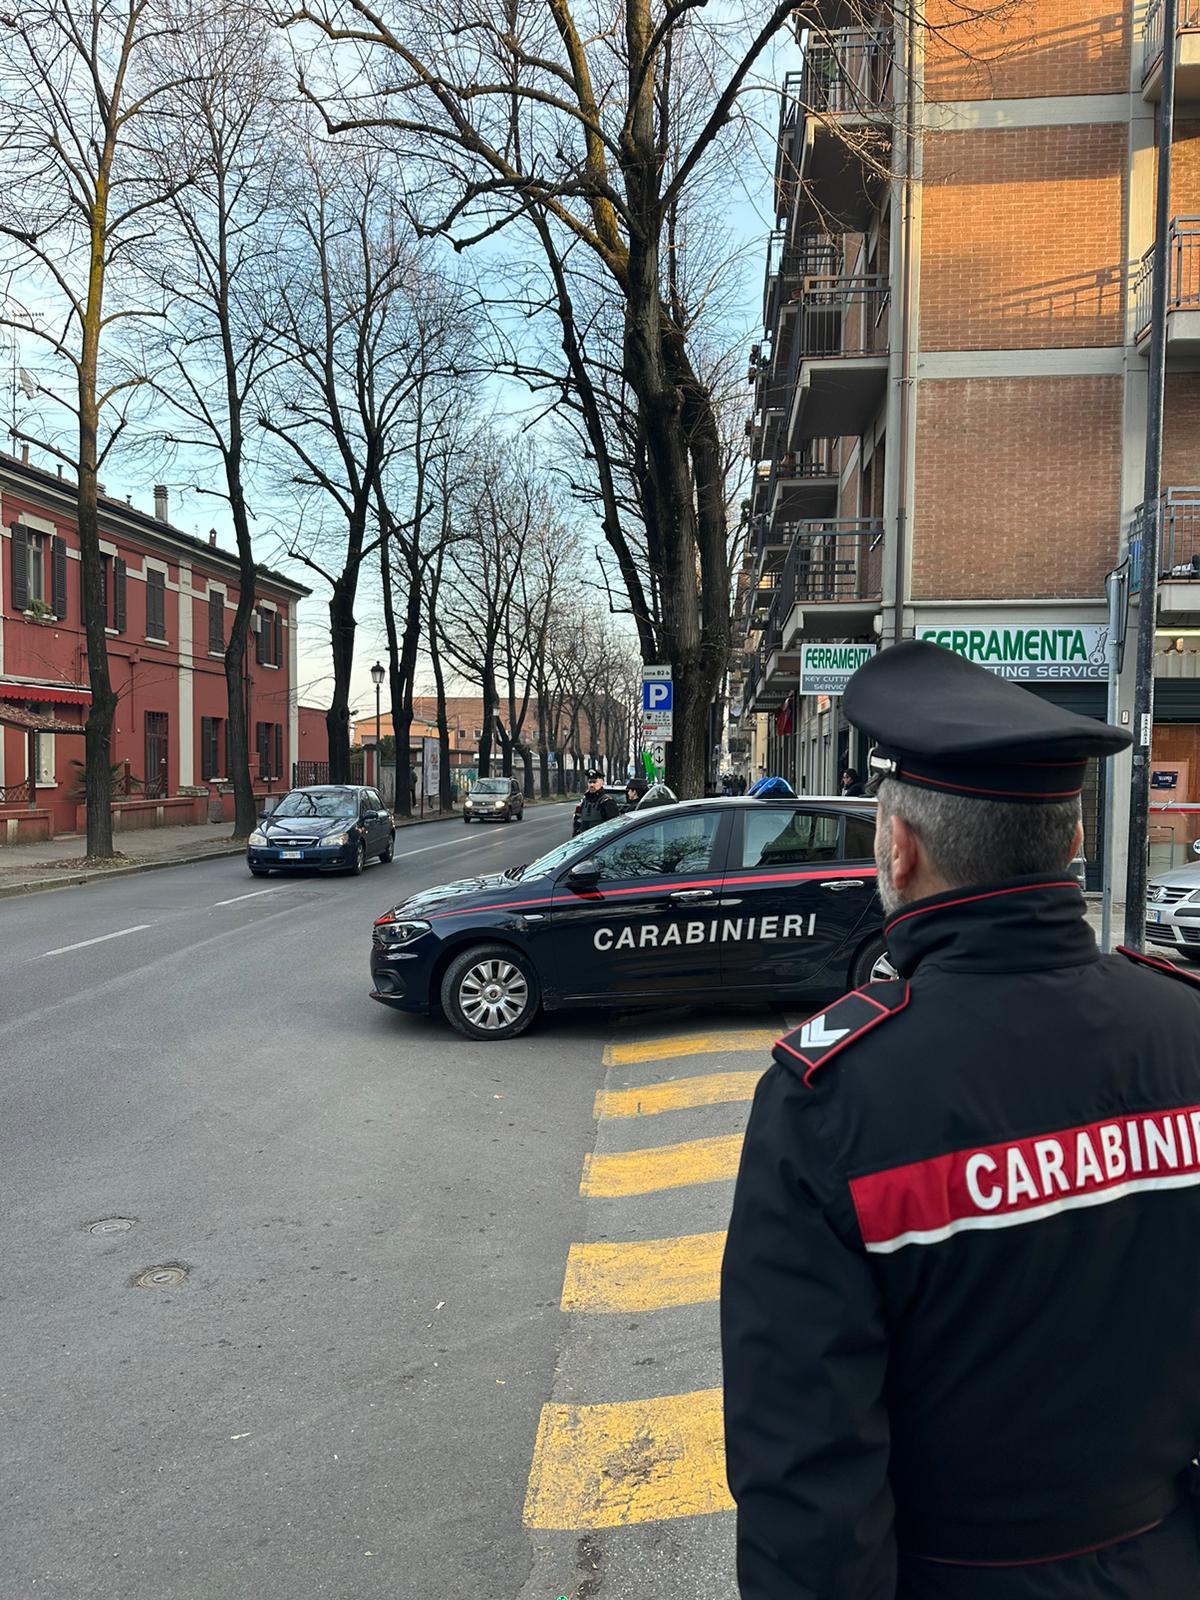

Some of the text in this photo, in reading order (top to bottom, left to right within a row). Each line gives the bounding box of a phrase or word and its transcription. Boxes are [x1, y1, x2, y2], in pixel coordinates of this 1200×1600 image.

[984, 666, 1108, 677] TING SERVICE
[649, 684, 669, 708] P
[593, 913, 817, 951] CARABINIERI
